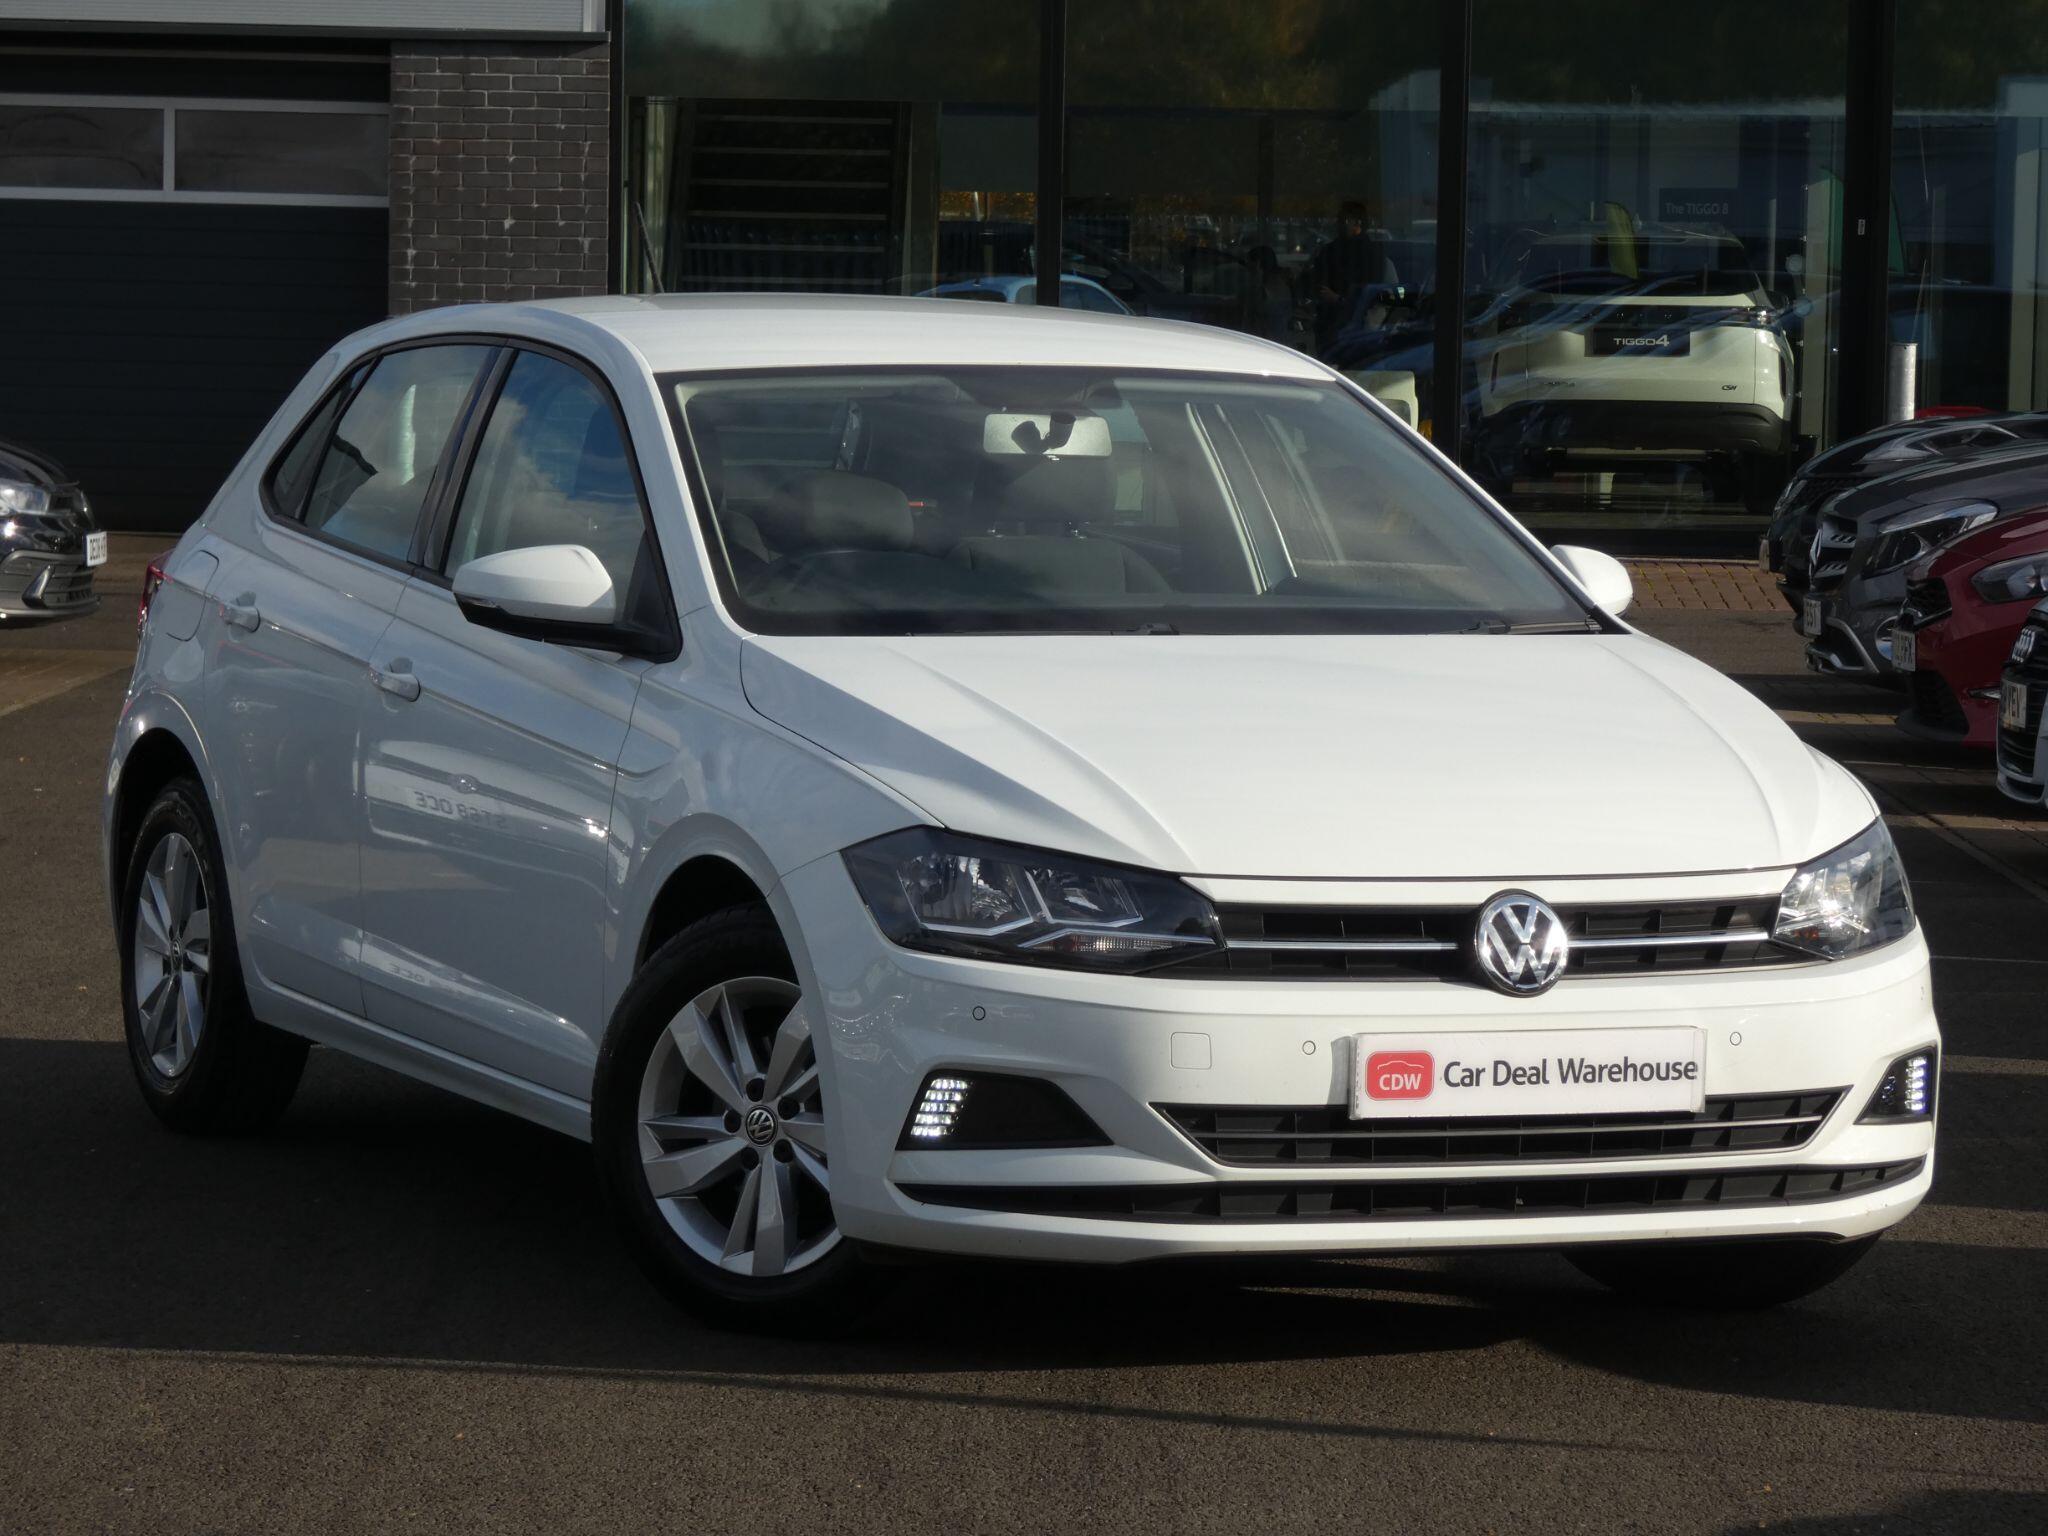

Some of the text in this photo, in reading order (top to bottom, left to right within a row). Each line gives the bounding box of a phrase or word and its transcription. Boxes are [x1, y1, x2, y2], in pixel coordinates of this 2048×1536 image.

[1664, 202, 1729, 214] The TIGGO 8
[1443, 1056, 1698, 1088] Car Deal Warehouse
[1379, 1073, 1422, 1091] CDW
